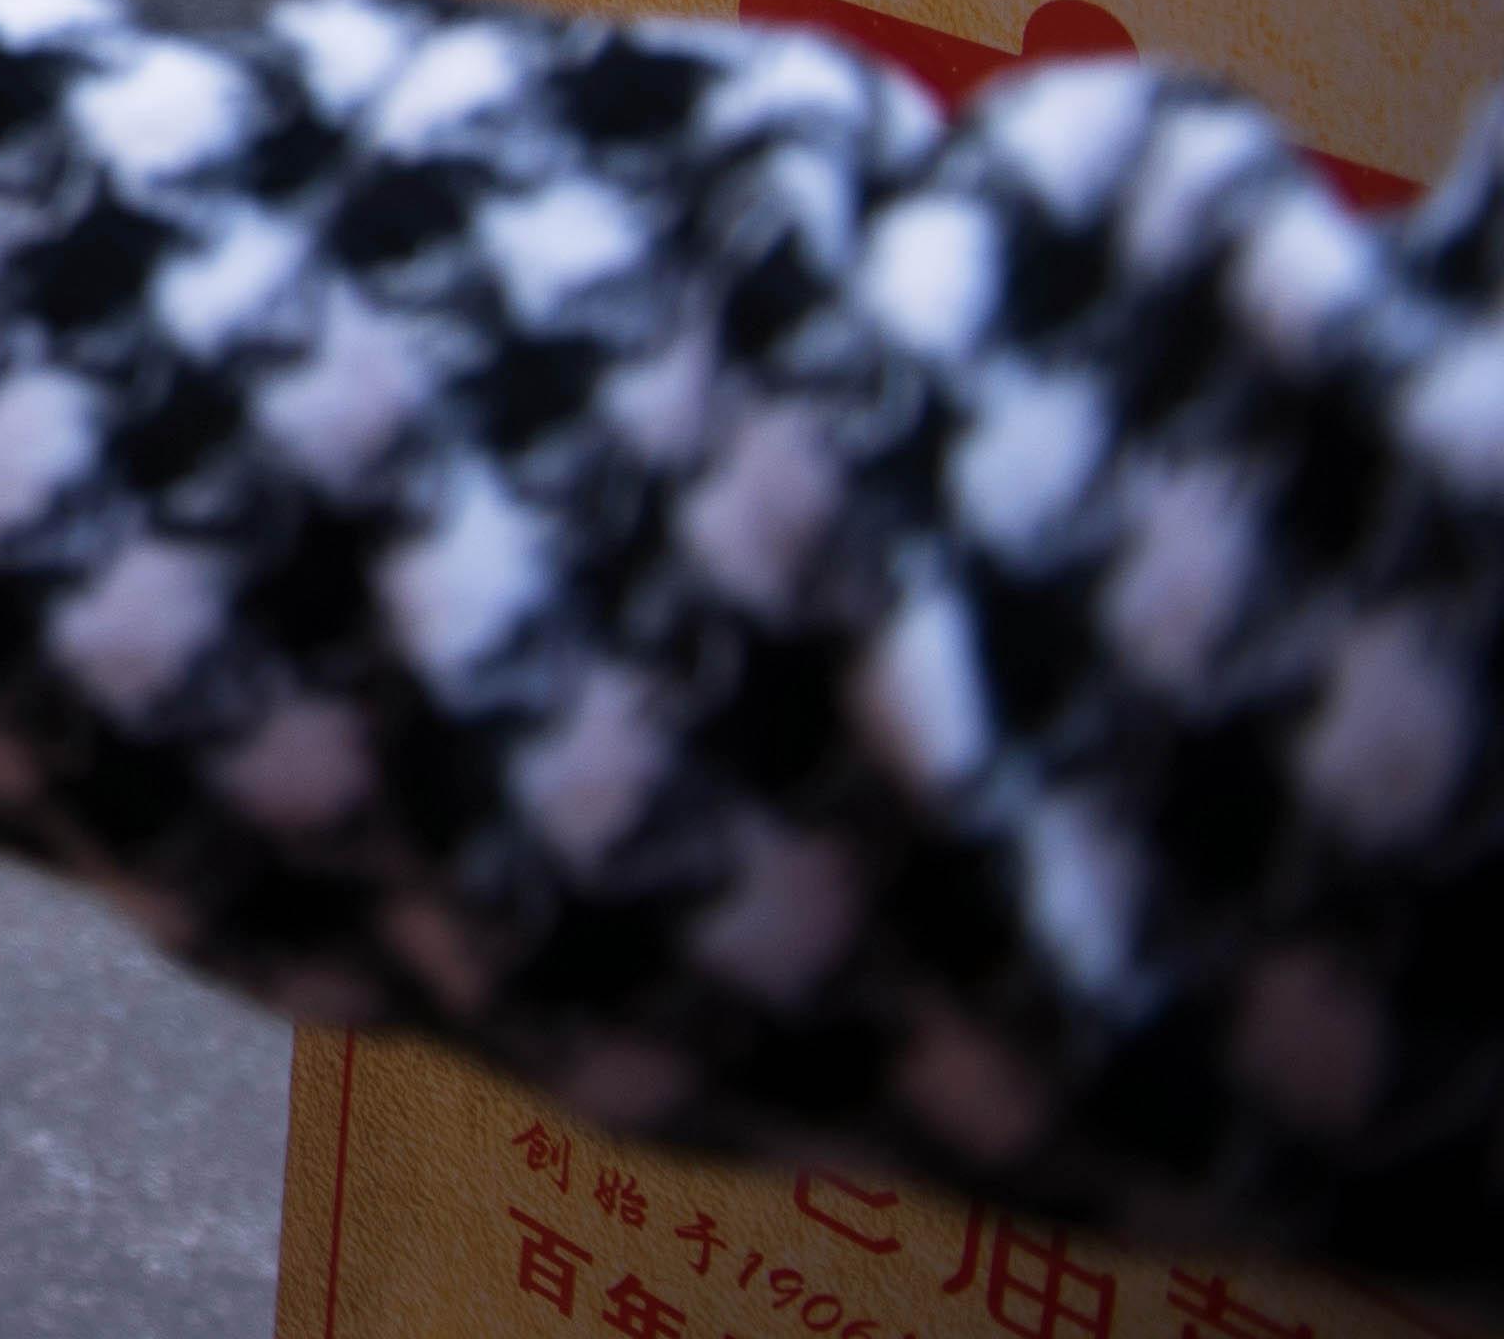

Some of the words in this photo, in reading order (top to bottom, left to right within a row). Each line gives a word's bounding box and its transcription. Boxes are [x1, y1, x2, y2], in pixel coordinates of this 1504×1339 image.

[508, 1205, 738, 1339] 百年
[511, 1120, 920, 1339] 创始于190
